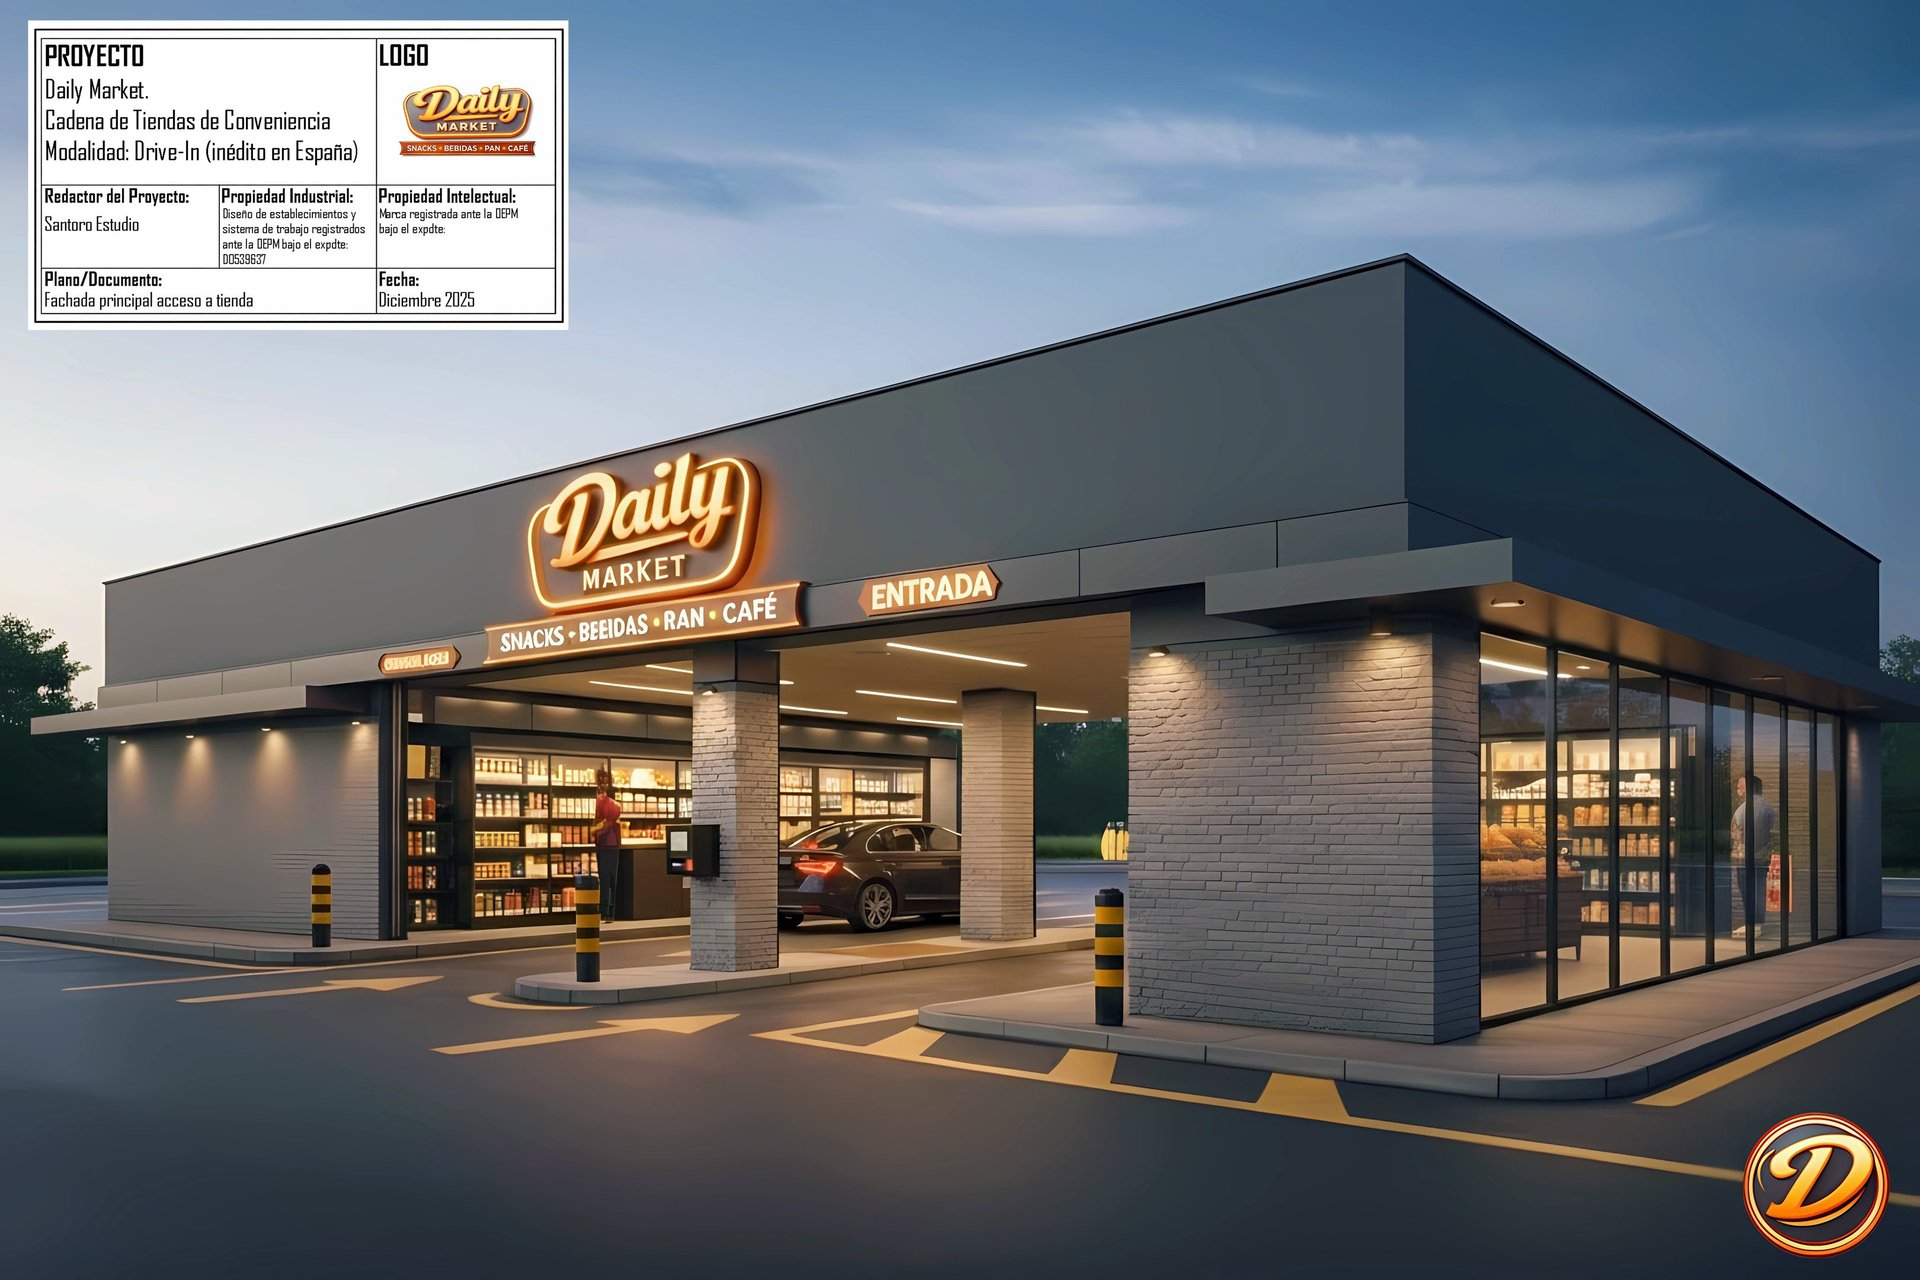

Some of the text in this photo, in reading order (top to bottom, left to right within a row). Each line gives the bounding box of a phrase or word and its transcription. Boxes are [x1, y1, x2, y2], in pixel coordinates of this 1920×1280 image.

[543, 452, 735, 568] Daily
[583, 554, 686, 591] MARKET
[872, 570, 992, 610] ENTRADA
[500, 625, 565, 653] SNACKS
[722, 592, 777, 624] CAFÉ
